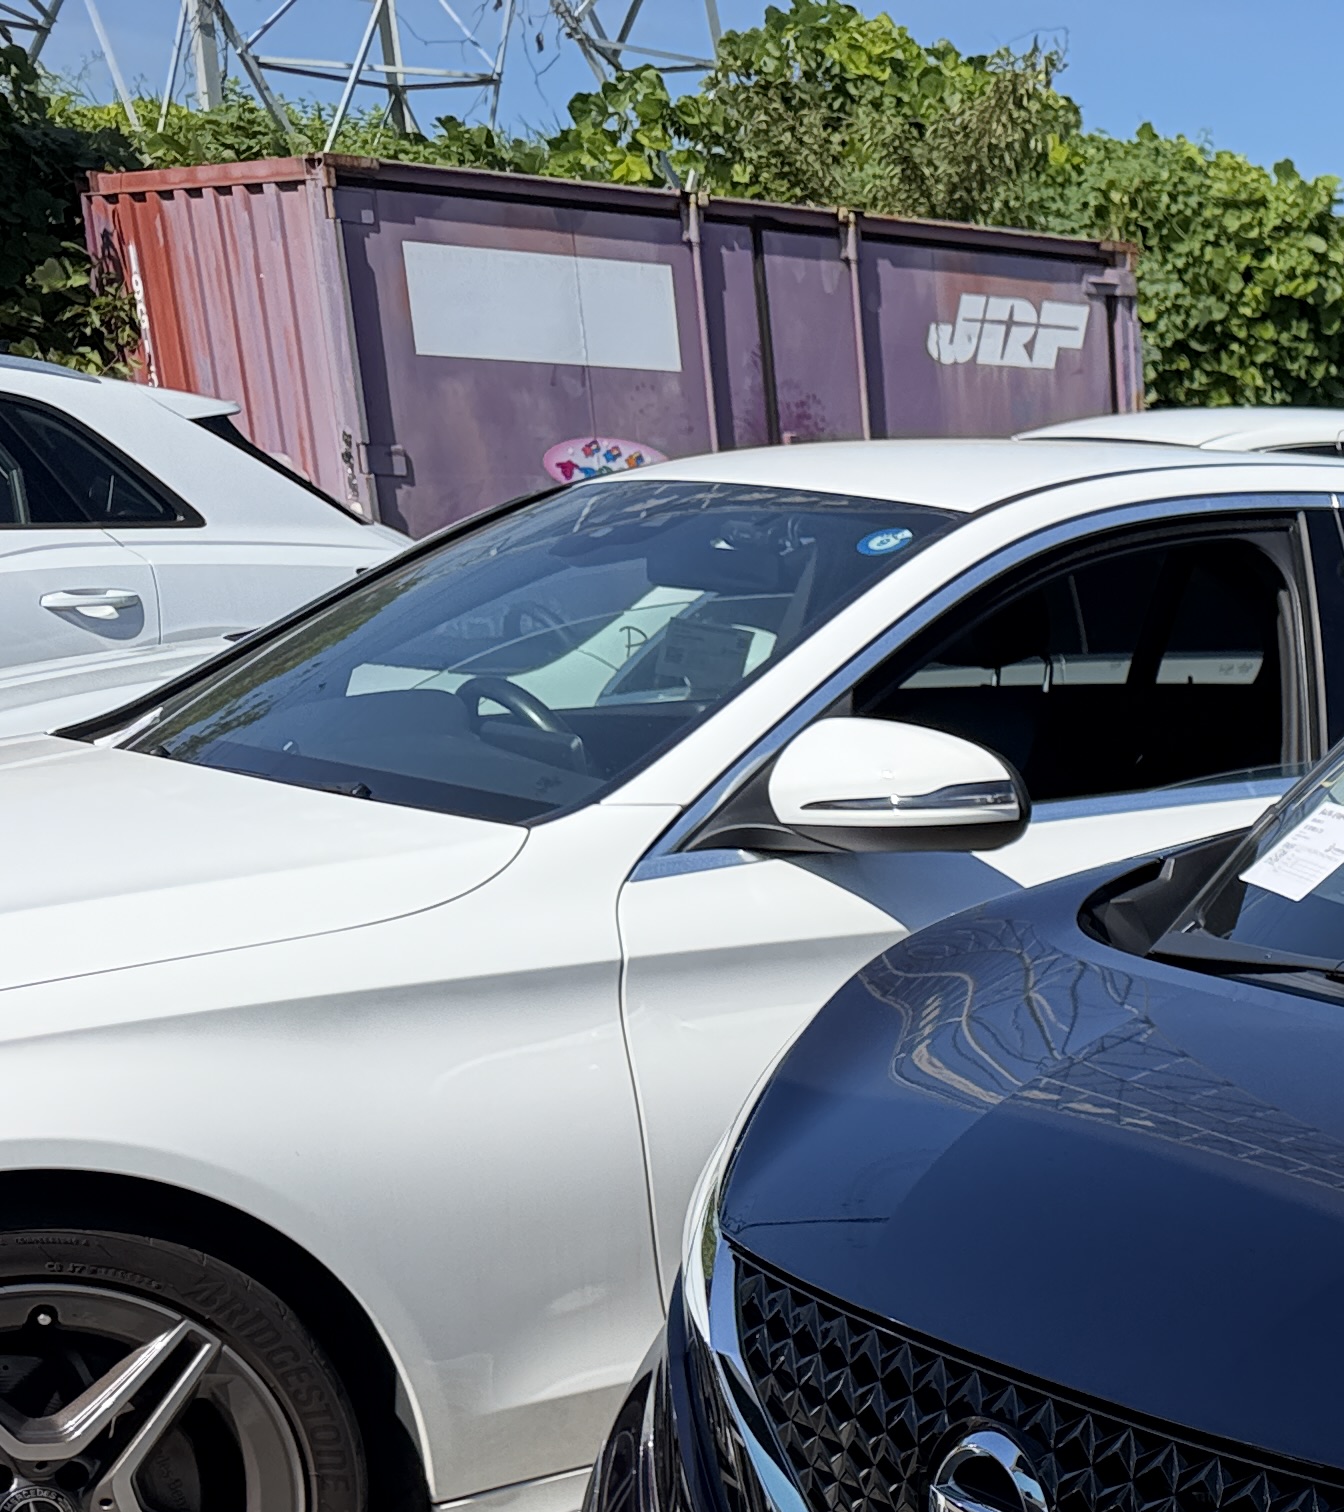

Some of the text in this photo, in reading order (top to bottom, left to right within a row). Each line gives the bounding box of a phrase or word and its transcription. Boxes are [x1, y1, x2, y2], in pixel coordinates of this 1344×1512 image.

[926, 292, 1091, 370] JRF
[182, 1273, 352, 1496] BRIDGESTONE
[3, 1487, 58, 1512] MERCEDES
